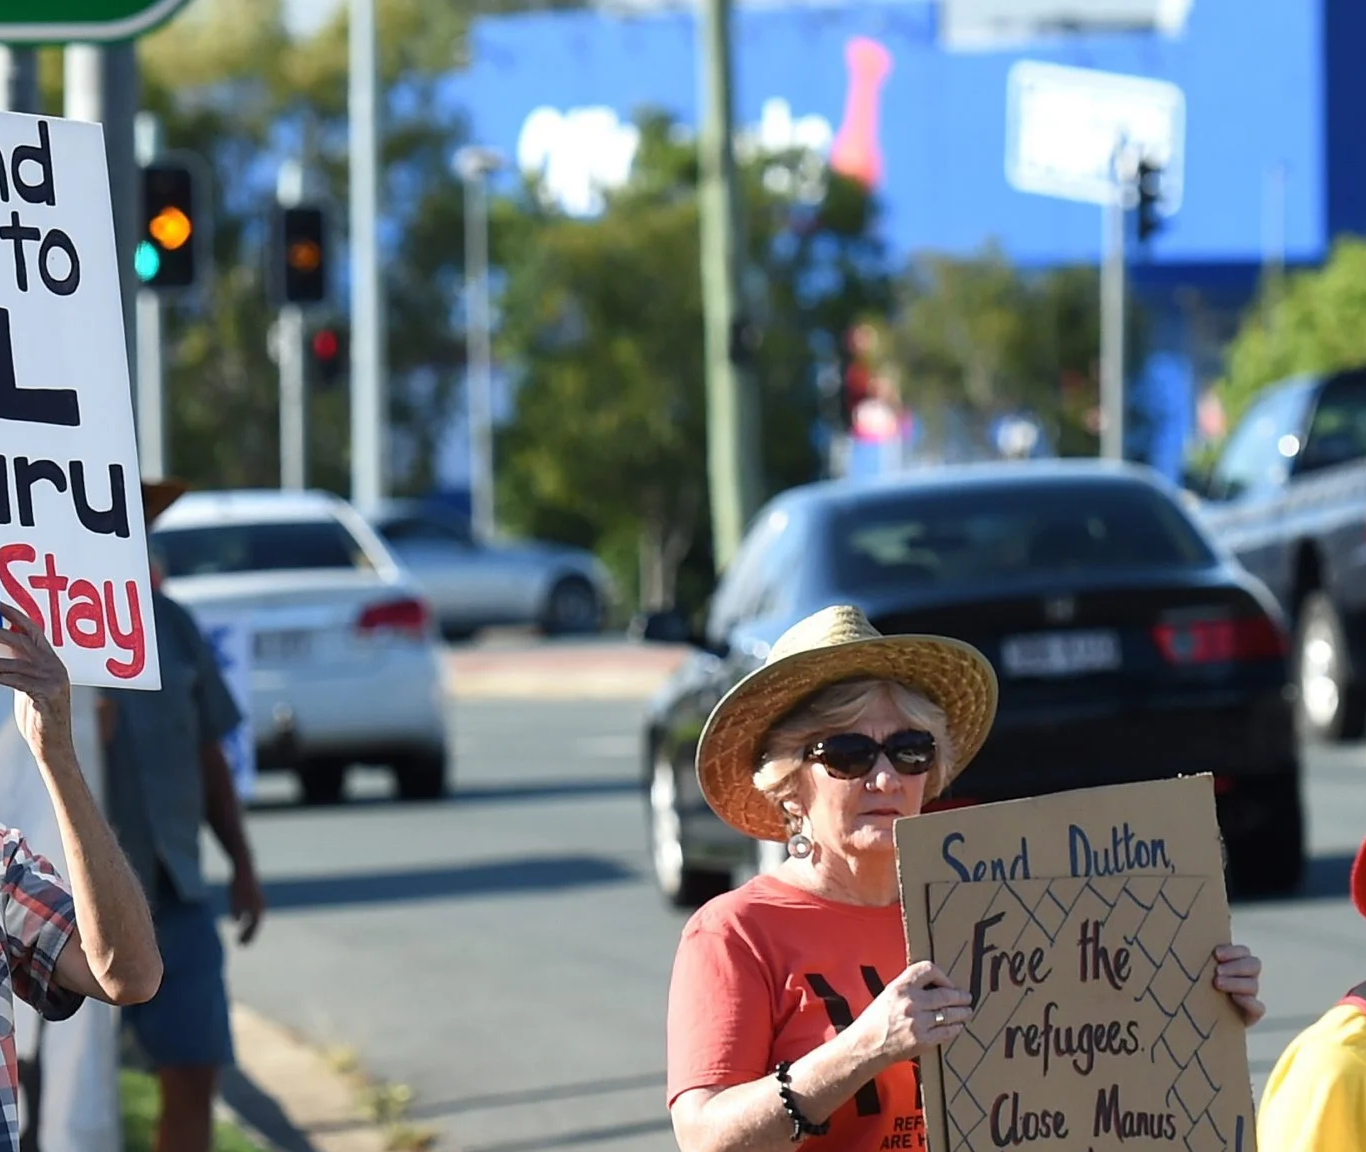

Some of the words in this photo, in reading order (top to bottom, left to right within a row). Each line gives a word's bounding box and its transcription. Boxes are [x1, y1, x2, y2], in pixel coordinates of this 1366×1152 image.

[941, 832, 1029, 882] Send
[1068, 822, 1176, 878] Dutton,
[970, 910, 1052, 1012] Free
[1077, 918, 1133, 991] the
[1003, 1002, 1146, 1077] refugees.
[879, 1132, 913, 1151] ARE
[989, 1091, 1069, 1147] Close
[1092, 1083, 1177, 1143] Manus
